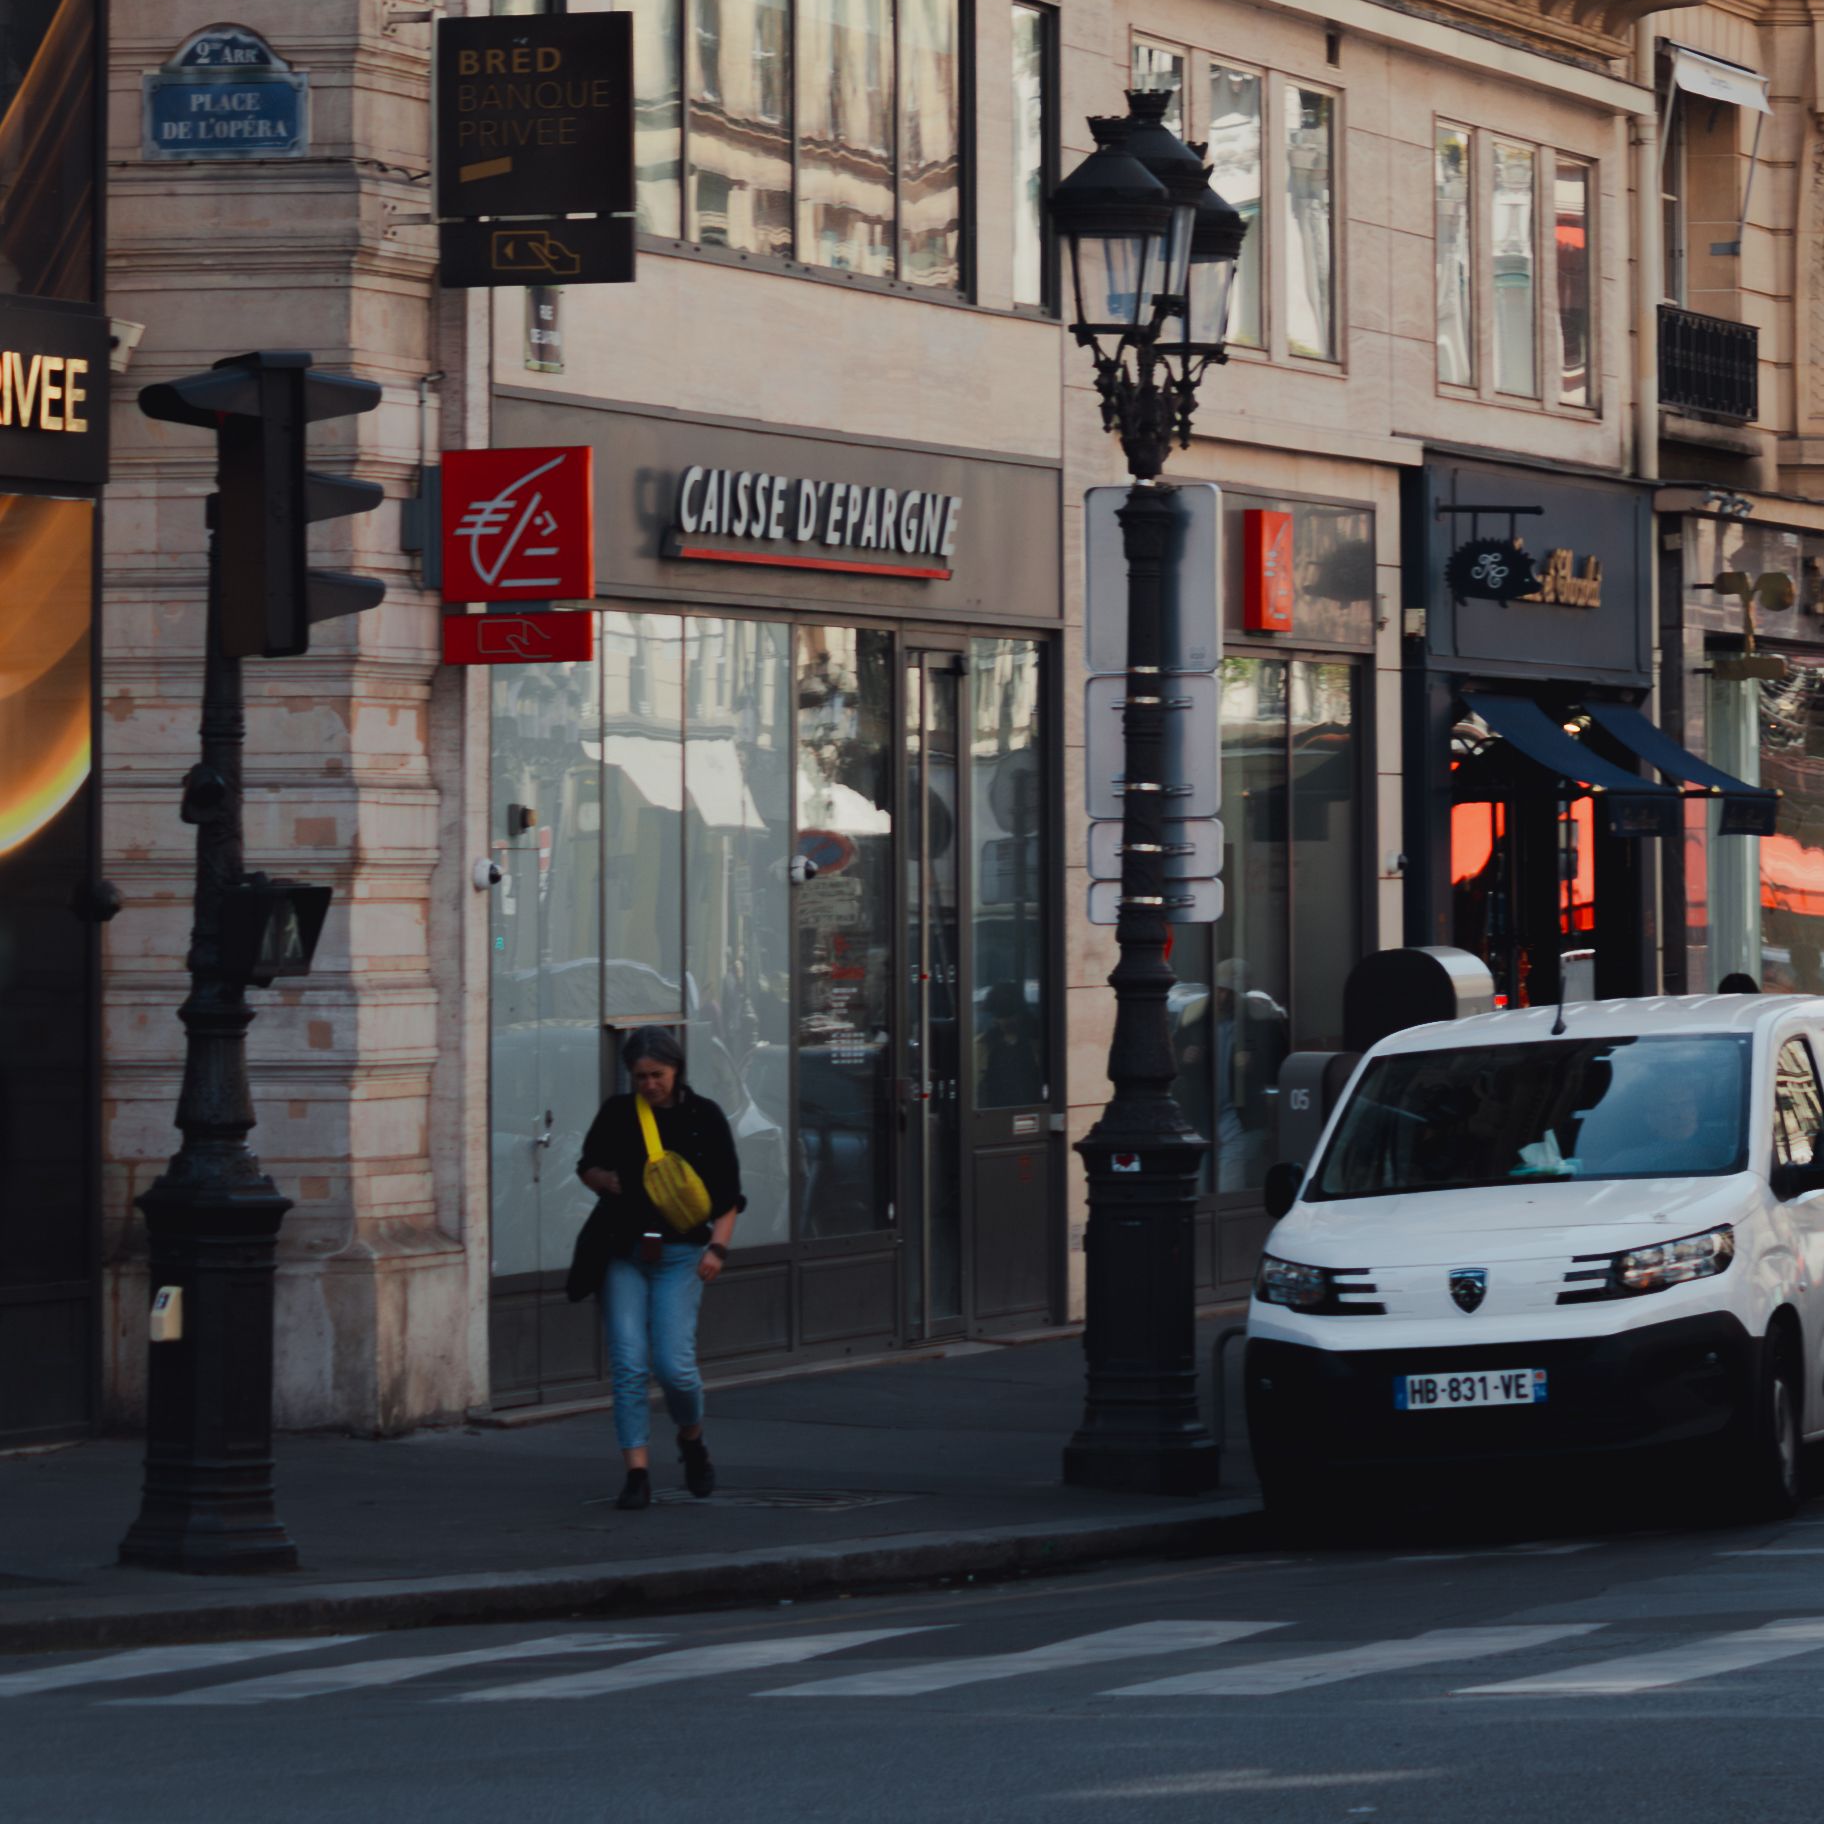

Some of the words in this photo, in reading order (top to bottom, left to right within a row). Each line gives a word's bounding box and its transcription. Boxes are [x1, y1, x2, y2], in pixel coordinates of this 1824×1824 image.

[457, 47, 562, 76] BRED
[190, 93, 262, 112] PLACE
[457, 79, 611, 112] BANQUE
[161, 122, 192, 140] DE
[198, 115, 289, 139] L'OPÉRA
[0, 350, 89, 434] IVEE
[680, 464, 789, 540] CAISSE
[797, 478, 963, 557] D'EPARGNE
[1290, 1088, 1311, 1110] 05
[1410, 1373, 1529, 1405] HB-831-VE
